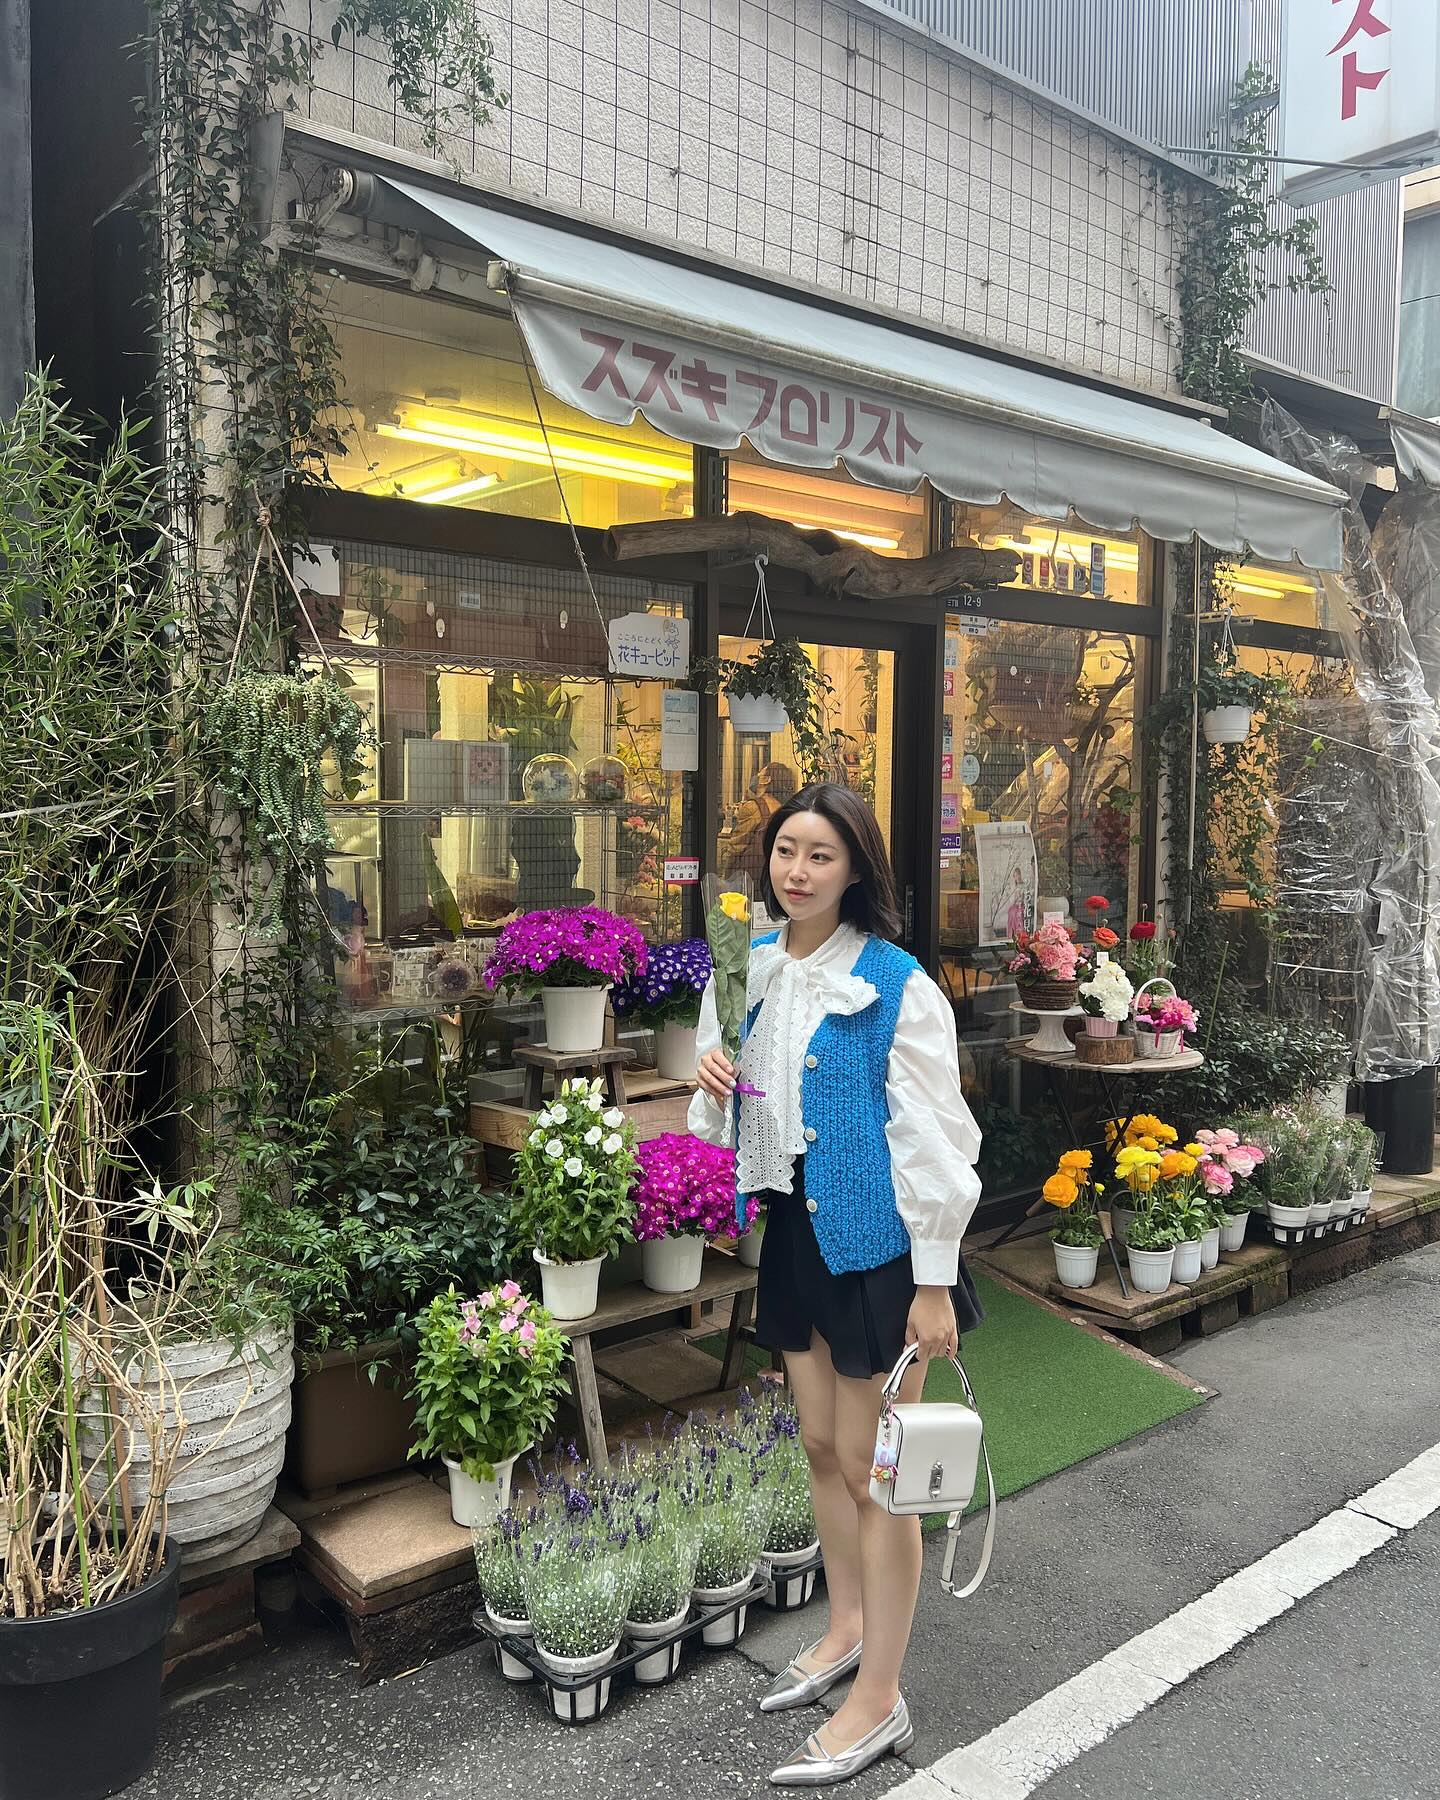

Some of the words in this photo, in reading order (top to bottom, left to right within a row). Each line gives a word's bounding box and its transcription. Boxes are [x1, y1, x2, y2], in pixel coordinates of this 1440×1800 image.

[963, 594, 982, 608] 12-9
[617, 633, 662, 645] こころにとどく
[618, 645, 681, 667] 花キューピット
